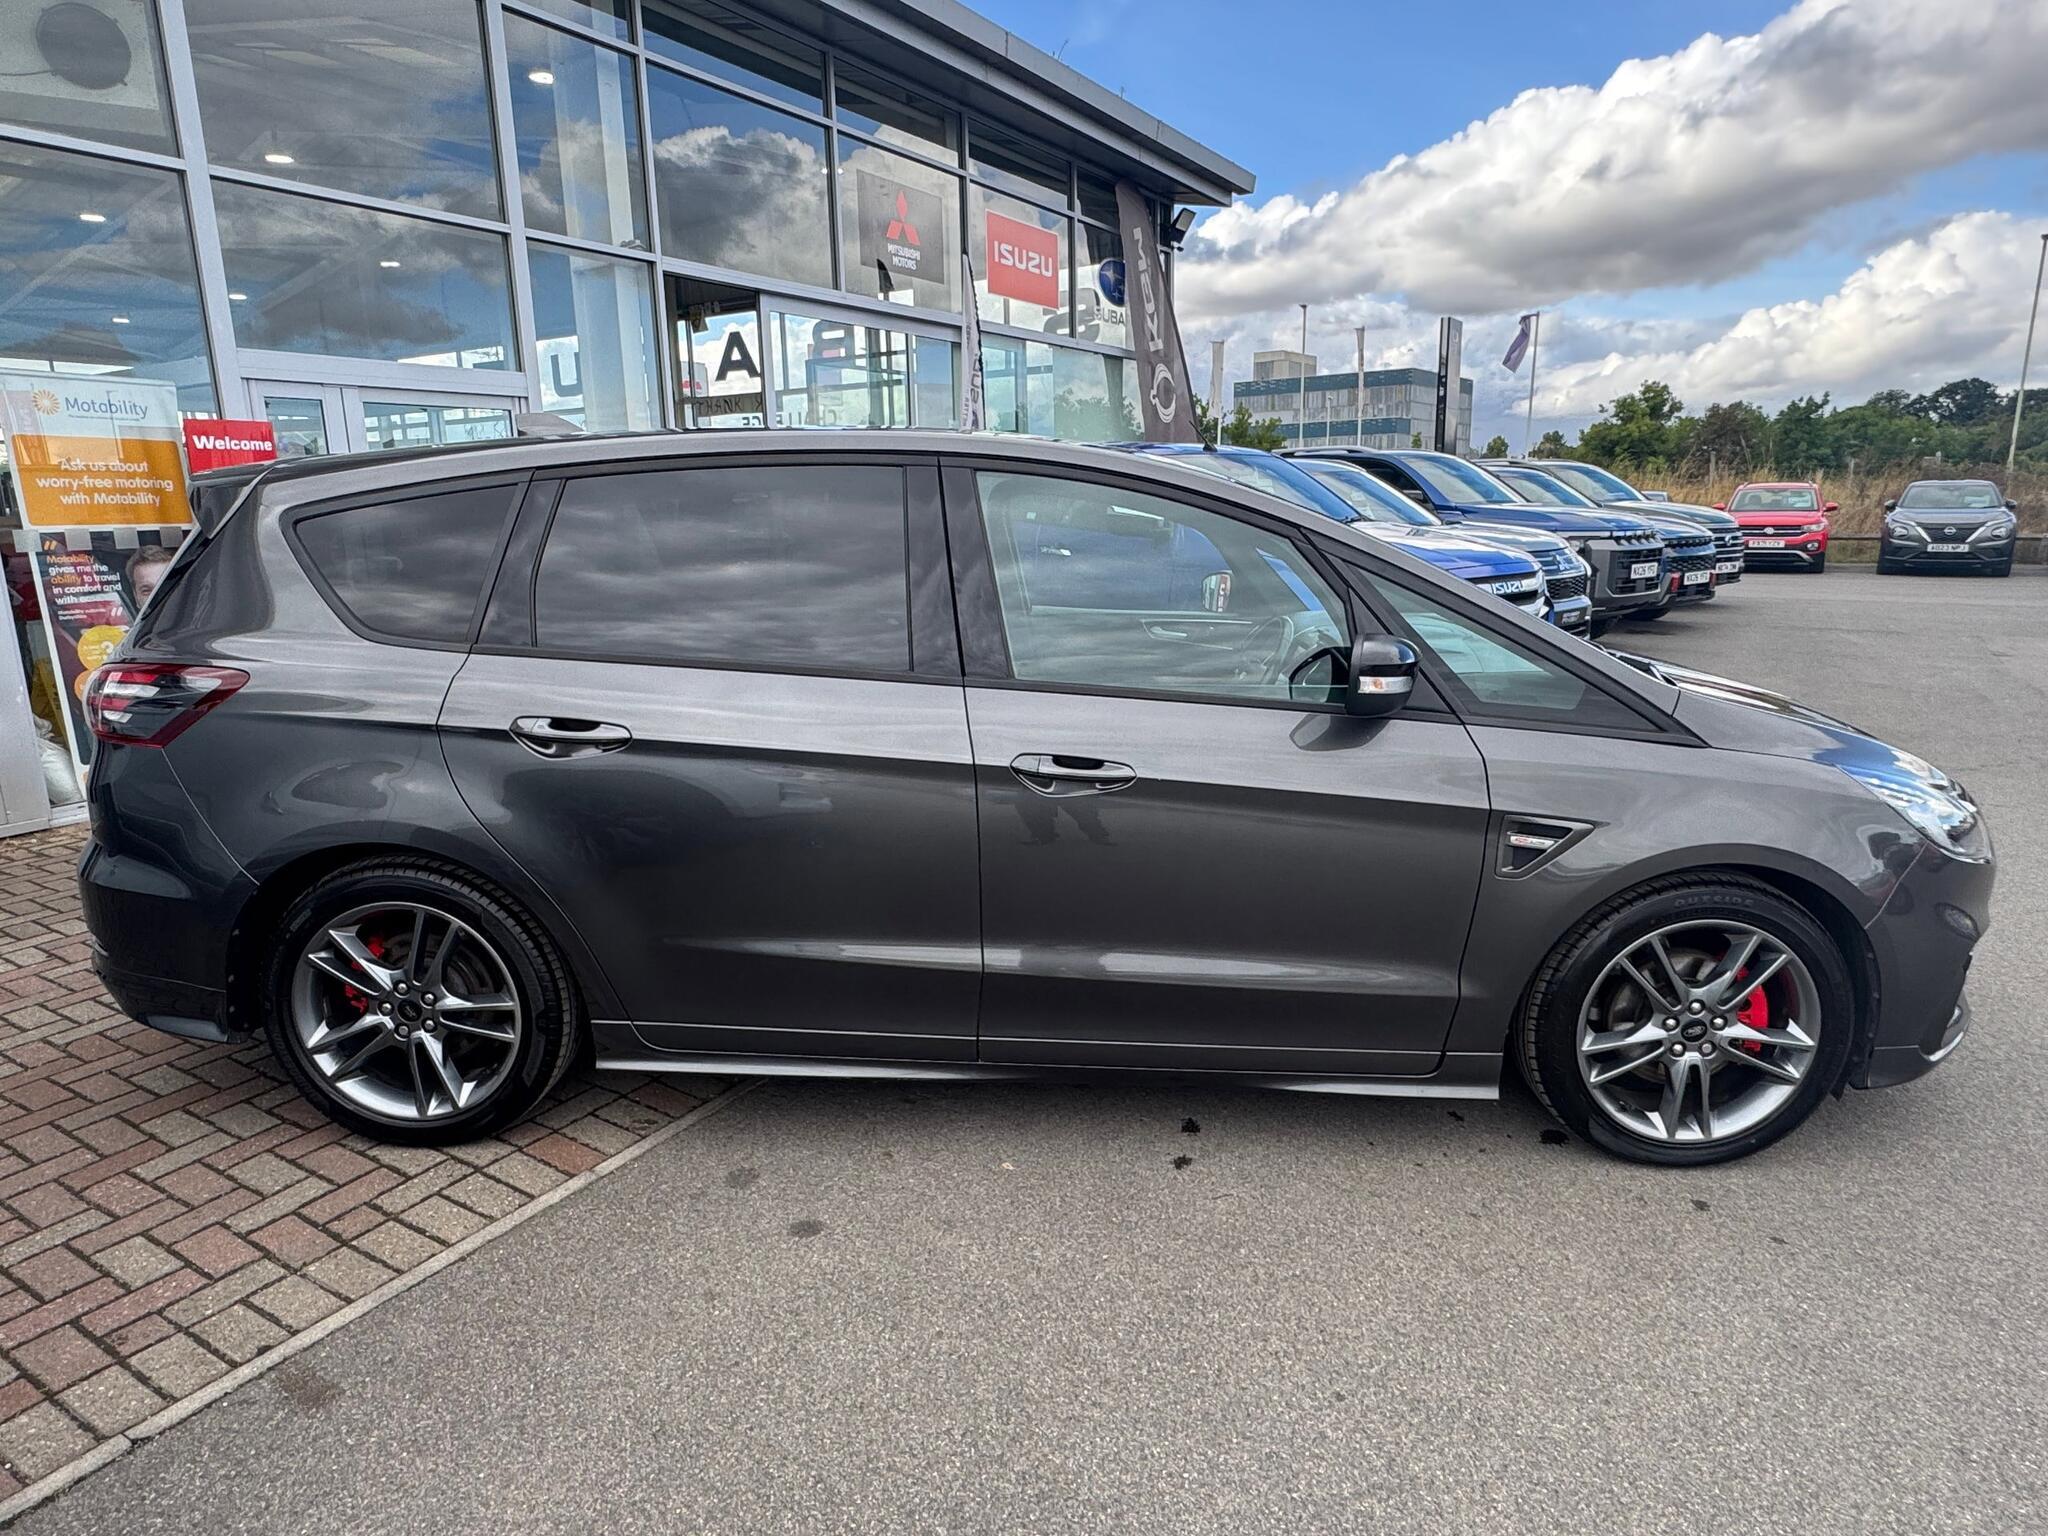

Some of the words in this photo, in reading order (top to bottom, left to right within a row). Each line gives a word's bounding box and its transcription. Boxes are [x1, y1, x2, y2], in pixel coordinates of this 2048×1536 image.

[887, 243, 921, 261] MITSUBISHI
[993, 240, 1053, 277] ISUZU
[892, 255, 917, 270] MOTORS
[1094, 305, 1125, 326] SUBA
[64, 396, 148, 418] Motability
[192, 435, 273, 451] Welcome
[60, 459, 87, 472] Ask
[90, 462, 106, 472] us
[109, 460, 148, 473] about
[36, 476, 112, 491] worry-free
[115, 477, 173, 492] motoring
[60, 493, 90, 505] with
[93, 493, 161, 507] Motability
[47, 554, 95, 564] Motability
[49, 565, 75, 576] gives
[93, 564, 109, 572] the
[51, 574, 82, 585] ability
[83, 574, 93, 582] to
[94, 572, 121, 581] travel
[52, 586, 63, 594] in
[64, 584, 101, 593] comfort
[103, 582, 122, 591] and
[1492, 581, 1526, 594] ISUZU
[55, 595, 78, 605] with
